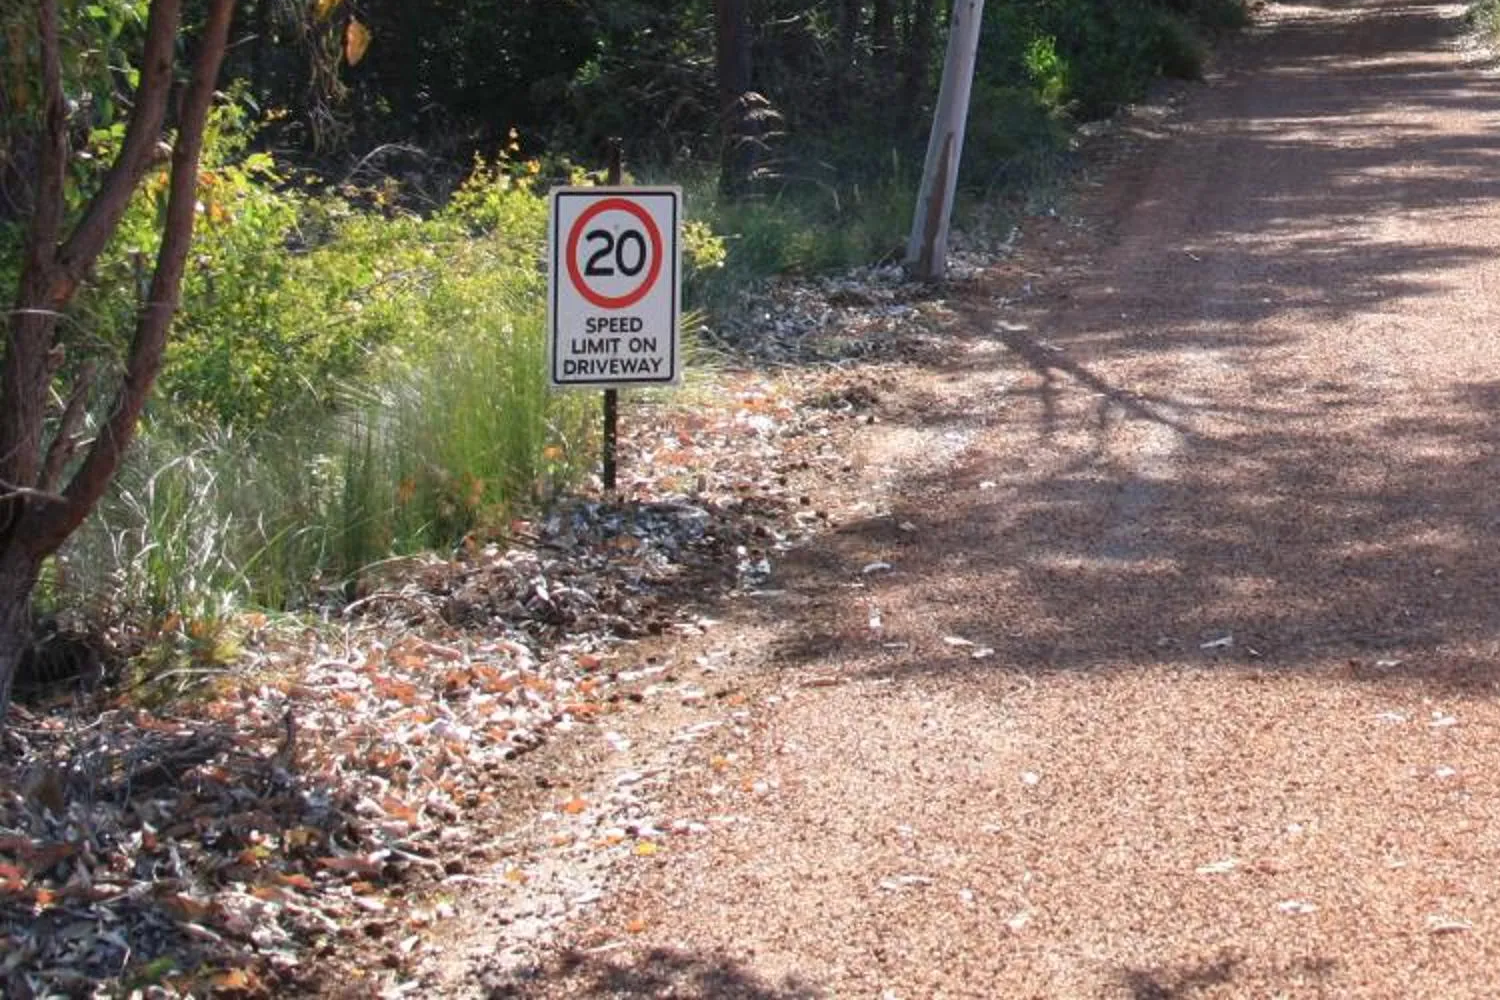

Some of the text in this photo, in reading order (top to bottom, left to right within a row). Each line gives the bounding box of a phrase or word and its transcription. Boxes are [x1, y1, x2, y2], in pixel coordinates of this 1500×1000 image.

[584, 229, 647, 277] 20
[585, 317, 643, 333] SPEED
[571, 337, 657, 354] LIMIT ON
[563, 357, 664, 375] DRIVEWAY
